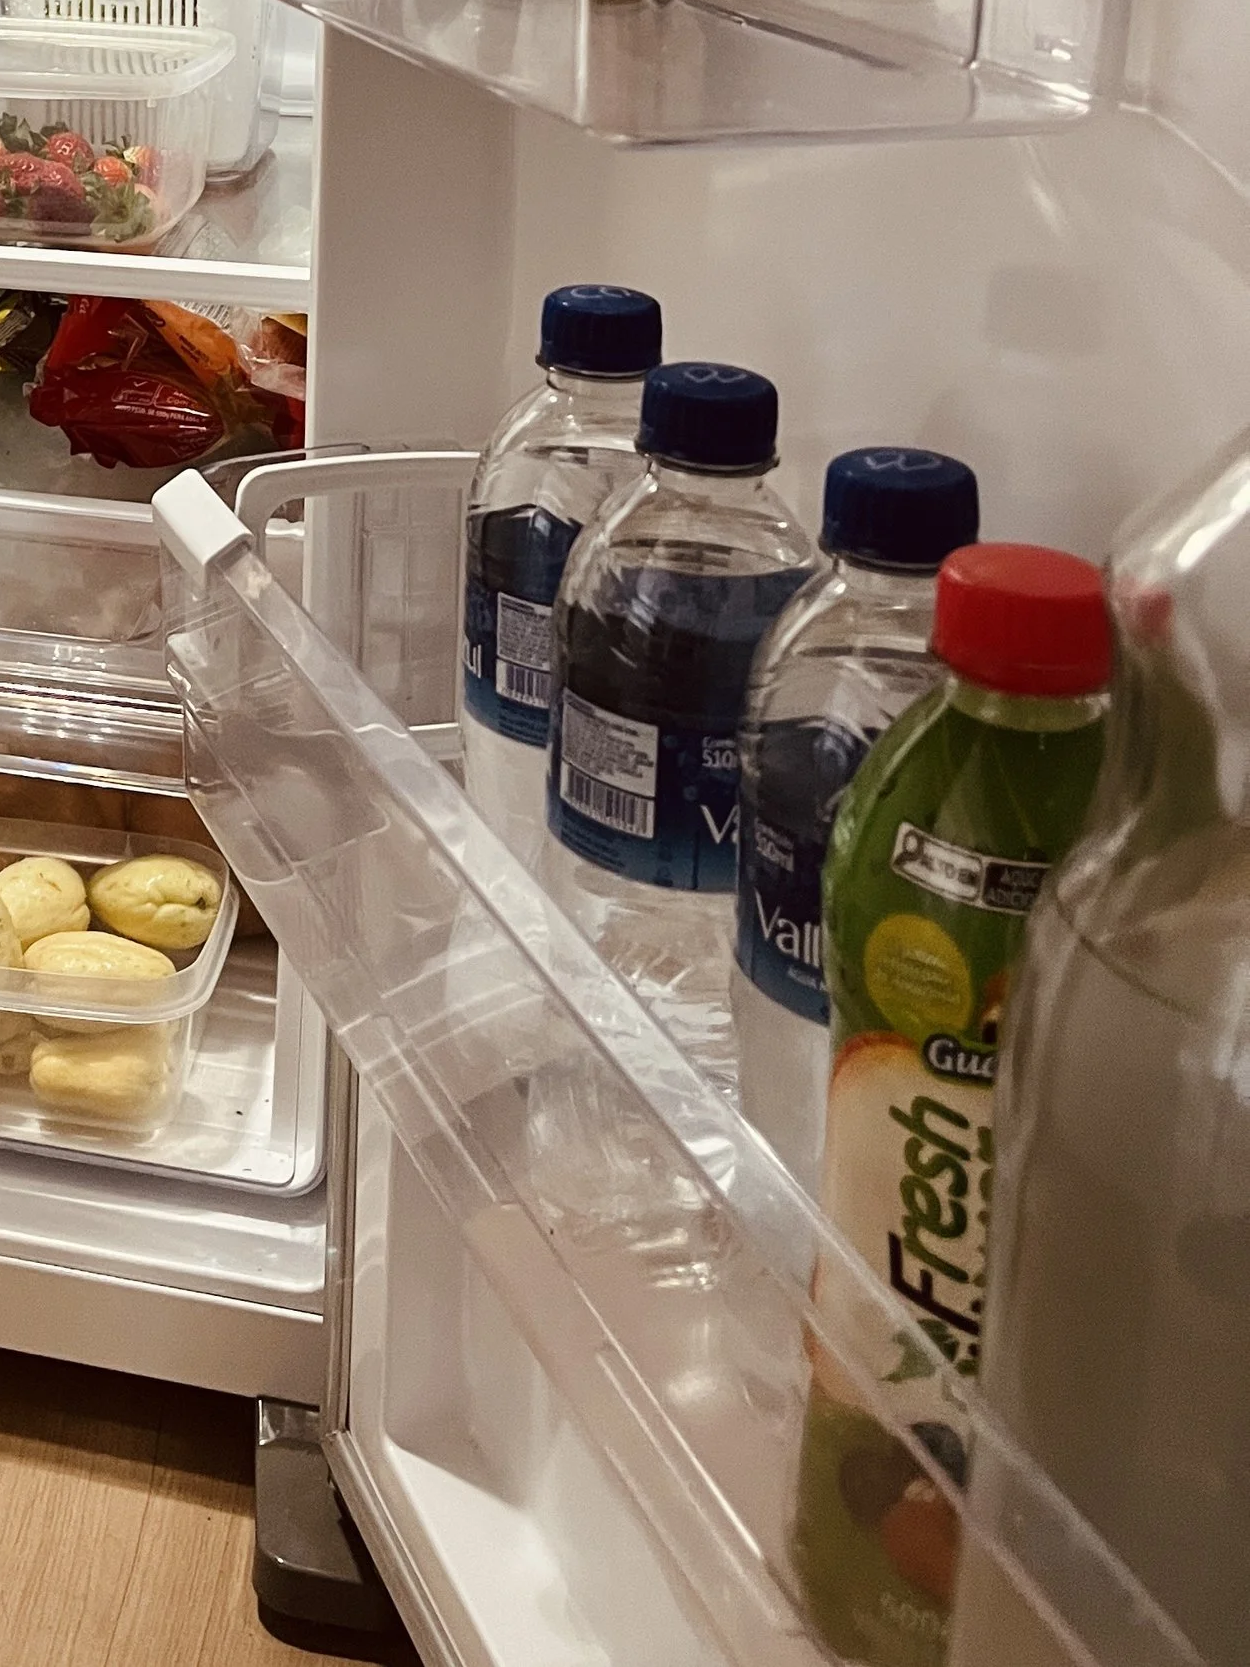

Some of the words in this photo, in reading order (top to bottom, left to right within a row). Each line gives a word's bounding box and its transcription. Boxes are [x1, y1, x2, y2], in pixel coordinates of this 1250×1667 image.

[753, 886, 821, 968] Vall
[928, 1038, 997, 1079] Gua
[888, 1095, 980, 1336] Fresh
